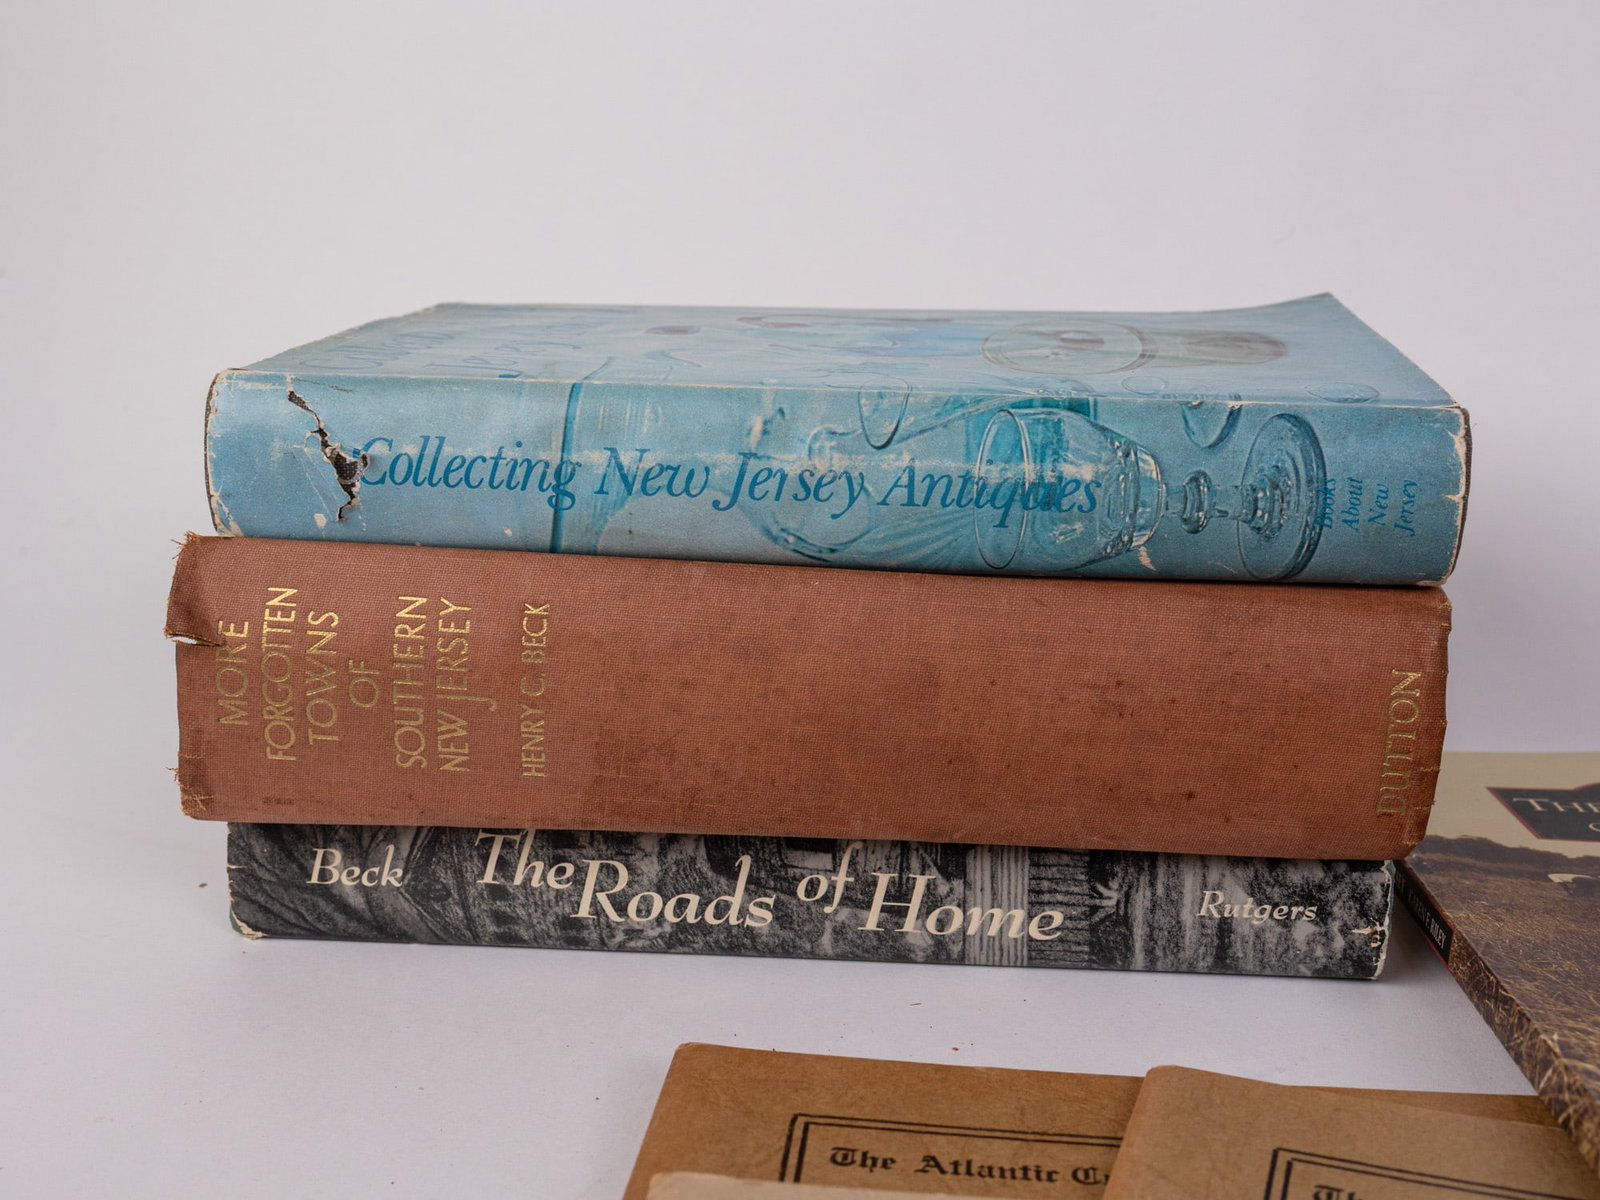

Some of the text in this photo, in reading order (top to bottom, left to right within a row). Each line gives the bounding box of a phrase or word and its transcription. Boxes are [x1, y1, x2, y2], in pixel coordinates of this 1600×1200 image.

[359, 435, 1103, 528] Collecting New Jersey Antiques
[1312, 478, 1336, 529] Books
[1341, 477, 1363, 532] About
[1368, 483, 1389, 526] New
[1393, 480, 1418, 537] Jersey
[215, 621, 249, 726] MORE
[260, 586, 299, 762] FORGOTTEN
[306, 610, 340, 745] TOWNS
[348, 659, 380, 708] OF
[393, 595, 429, 769] SOUTHERN
[436, 597, 498, 772] NEW JERSEY
[520, 602, 551, 777] HENRY C. BECK
[1377, 669, 1422, 815] DUTTON
[306, 844, 403, 888] Beck
[475, 828, 1065, 941] The Roads of Home
[1197, 890, 1318, 924] Rutgers
[829, 1147, 897, 1173] The
[914, 1154, 1060, 1184] Atlantic
